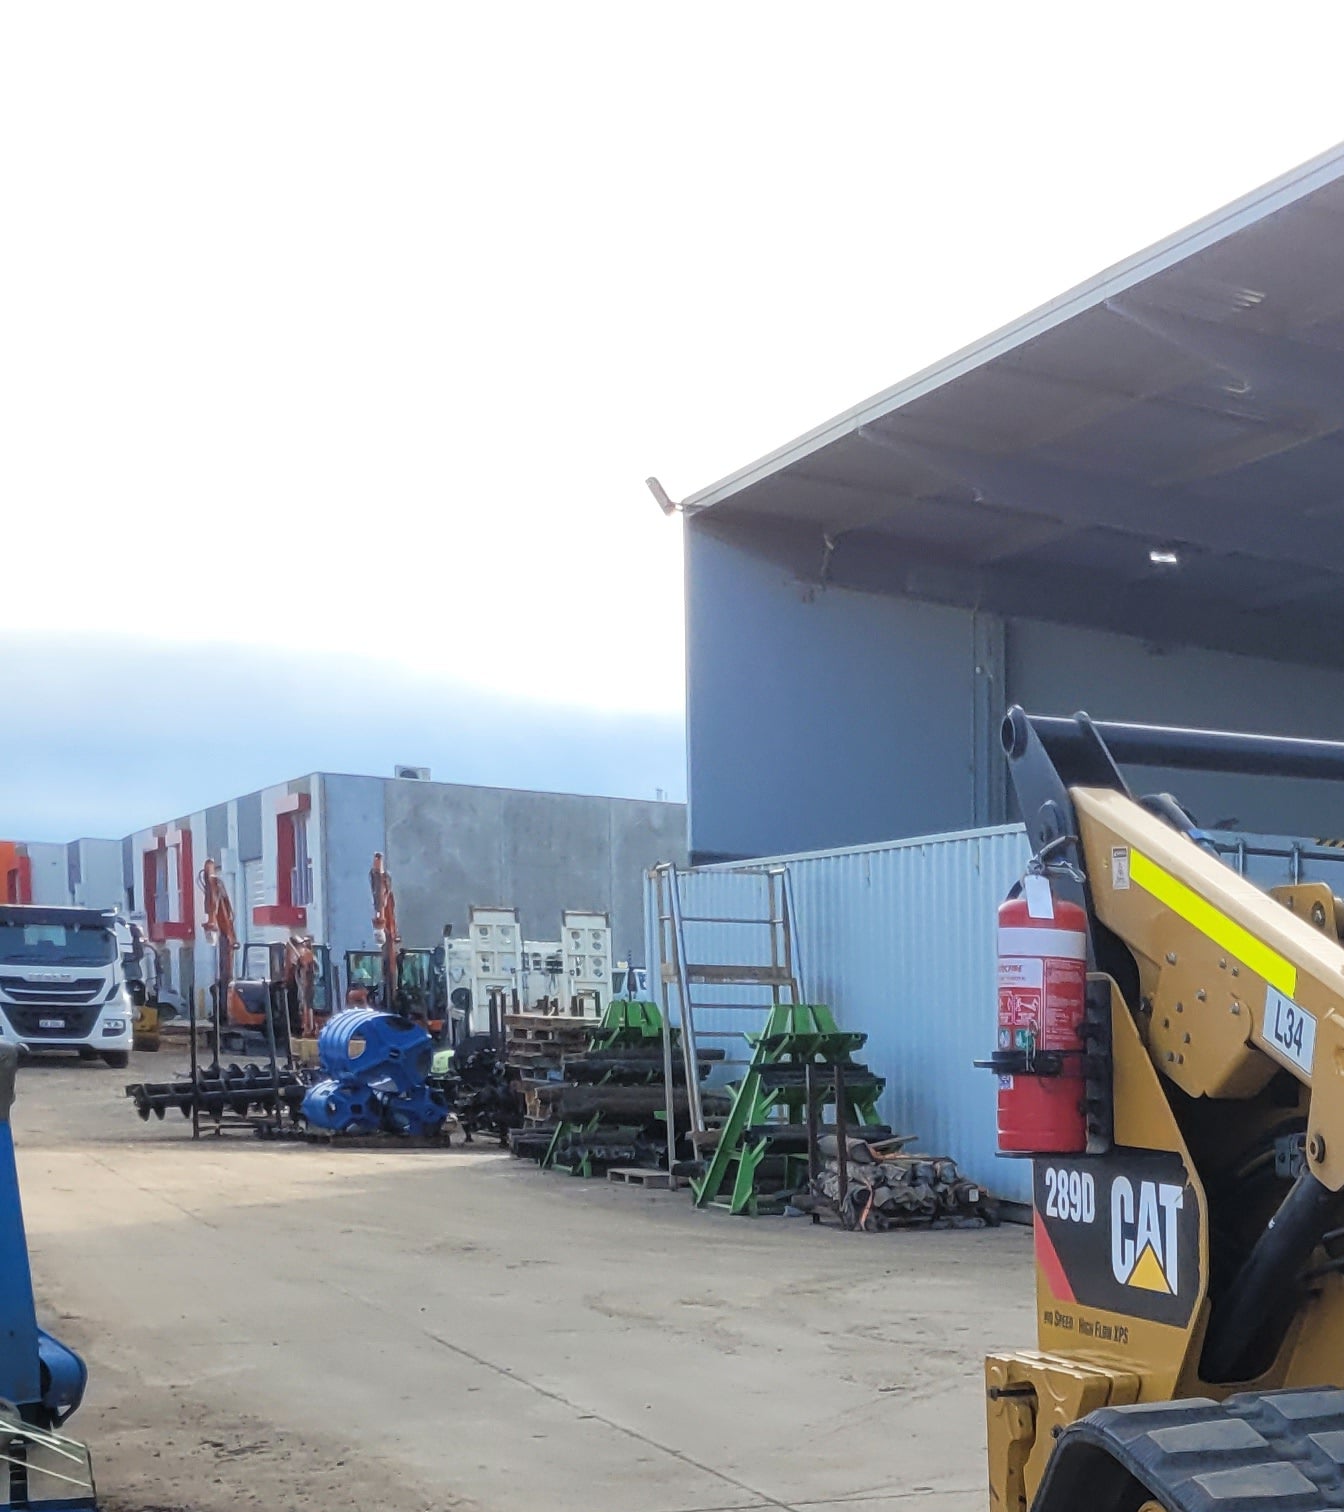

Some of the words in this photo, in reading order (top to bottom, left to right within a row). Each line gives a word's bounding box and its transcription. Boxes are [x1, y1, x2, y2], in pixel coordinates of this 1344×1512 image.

[1274, 999, 1304, 1057] L34
[1045, 1166, 1096, 1224] 289D
[1111, 1175, 1184, 1297] CAT
